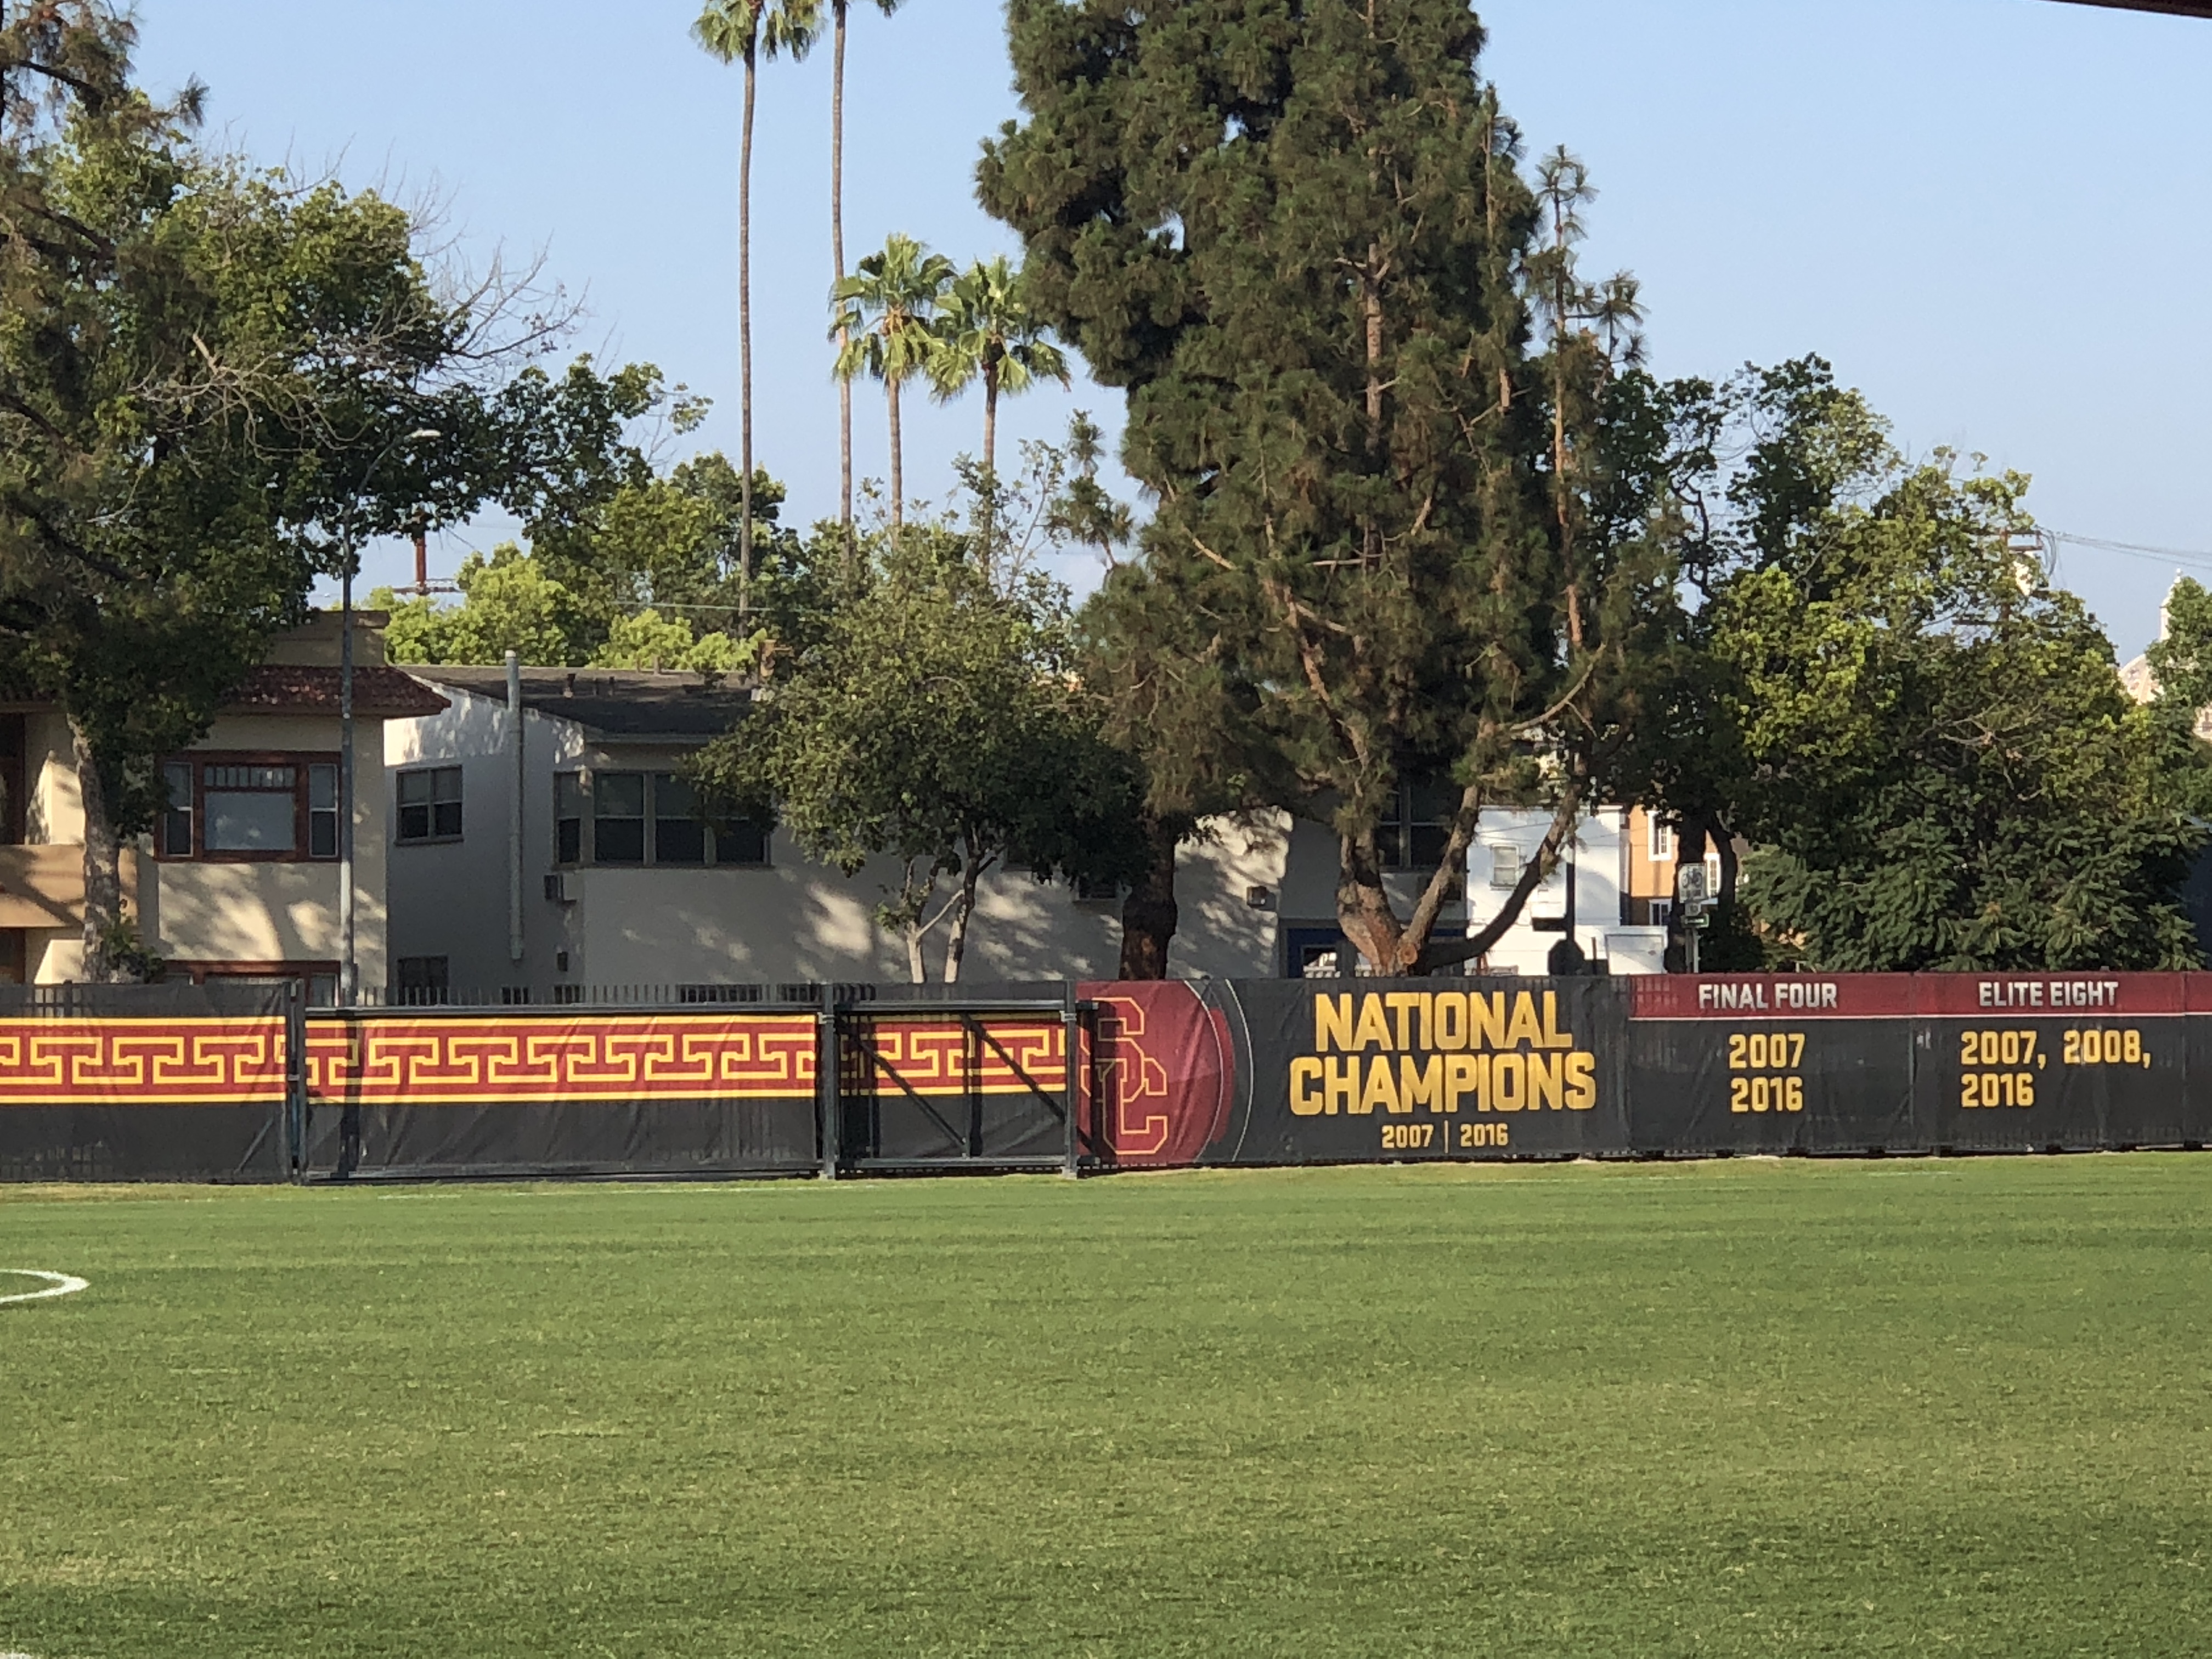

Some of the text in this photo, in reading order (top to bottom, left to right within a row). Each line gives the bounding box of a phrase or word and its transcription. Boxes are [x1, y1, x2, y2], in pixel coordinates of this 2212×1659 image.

[1699, 982, 1837, 1009] FINAL FOUR
[1978, 980, 2119, 1007] ELITE EIGHT
[1315, 990, 1573, 1052] NATIONAL
[1729, 1033, 1805, 1069] 2007
[1961, 1029, 2151, 1070] 2007, 2008,
[1289, 1052, 1596, 1115] CHAMPIONS
[1731, 1076, 1803, 1113] 2016
[1961, 1073, 2034, 1107] 2016
[1381, 1122, 1509, 1148] 2007 2016
